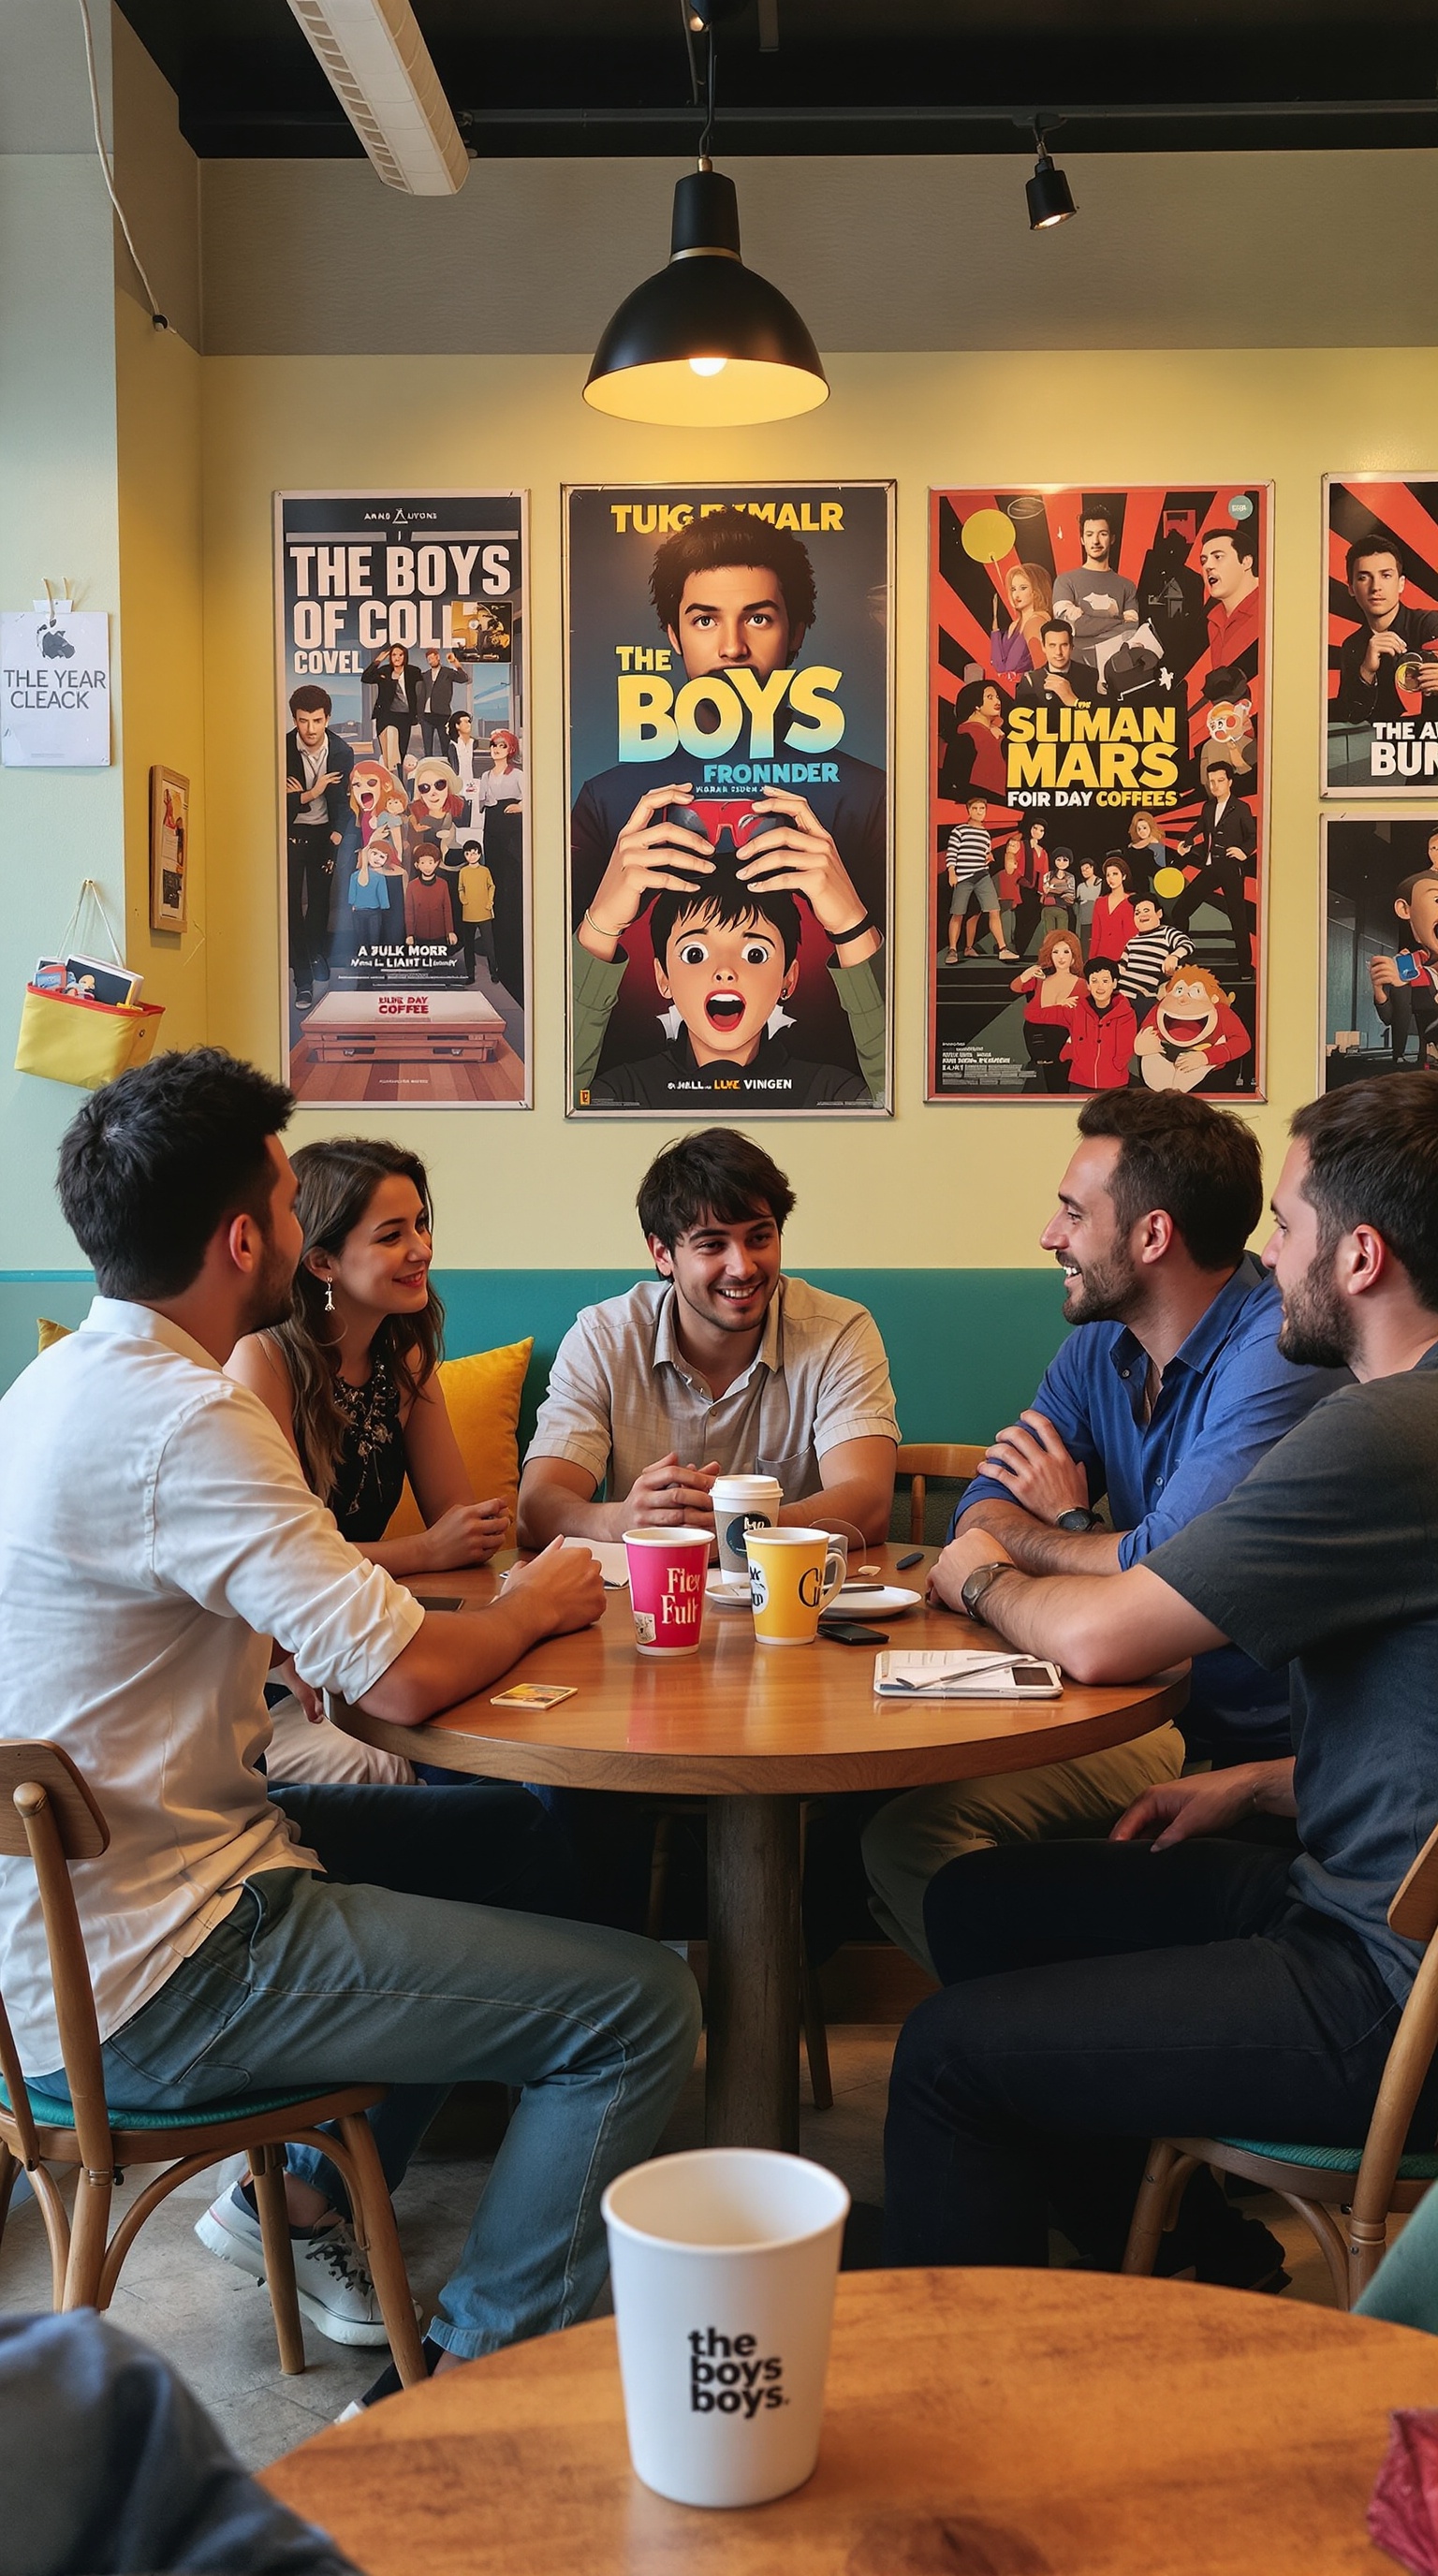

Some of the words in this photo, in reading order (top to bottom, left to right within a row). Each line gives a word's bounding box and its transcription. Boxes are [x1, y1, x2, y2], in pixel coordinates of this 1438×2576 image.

[289, 546, 373, 597] THE
[386, 545, 511, 596] BOYS
[293, 600, 348, 649] OF
[293, 650, 364, 674] COVEL
[615, 645, 672, 671] THE
[53, 669, 107, 689] YEAR
[10, 690, 90, 710] CLEACK
[617, 666, 845, 763] BOYS
[1006, 707, 1176, 743] SLIMAN
[1372, 722, 1416, 739] THE
[1418, 721, 1438, 739] A
[703, 762, 841, 784] FRONNDER
[1006, 741, 1180, 789] MARS
[1007, 791, 1050, 808] FOIR
[1055, 791, 1093, 808] DAY
[1095, 790, 1179, 808] COFFEES
[358, 945, 368, 957] A
[378, 1004, 429, 1014] COFFEE
[687, 2326, 757, 2358] the
[690, 2355, 783, 2387] boys
